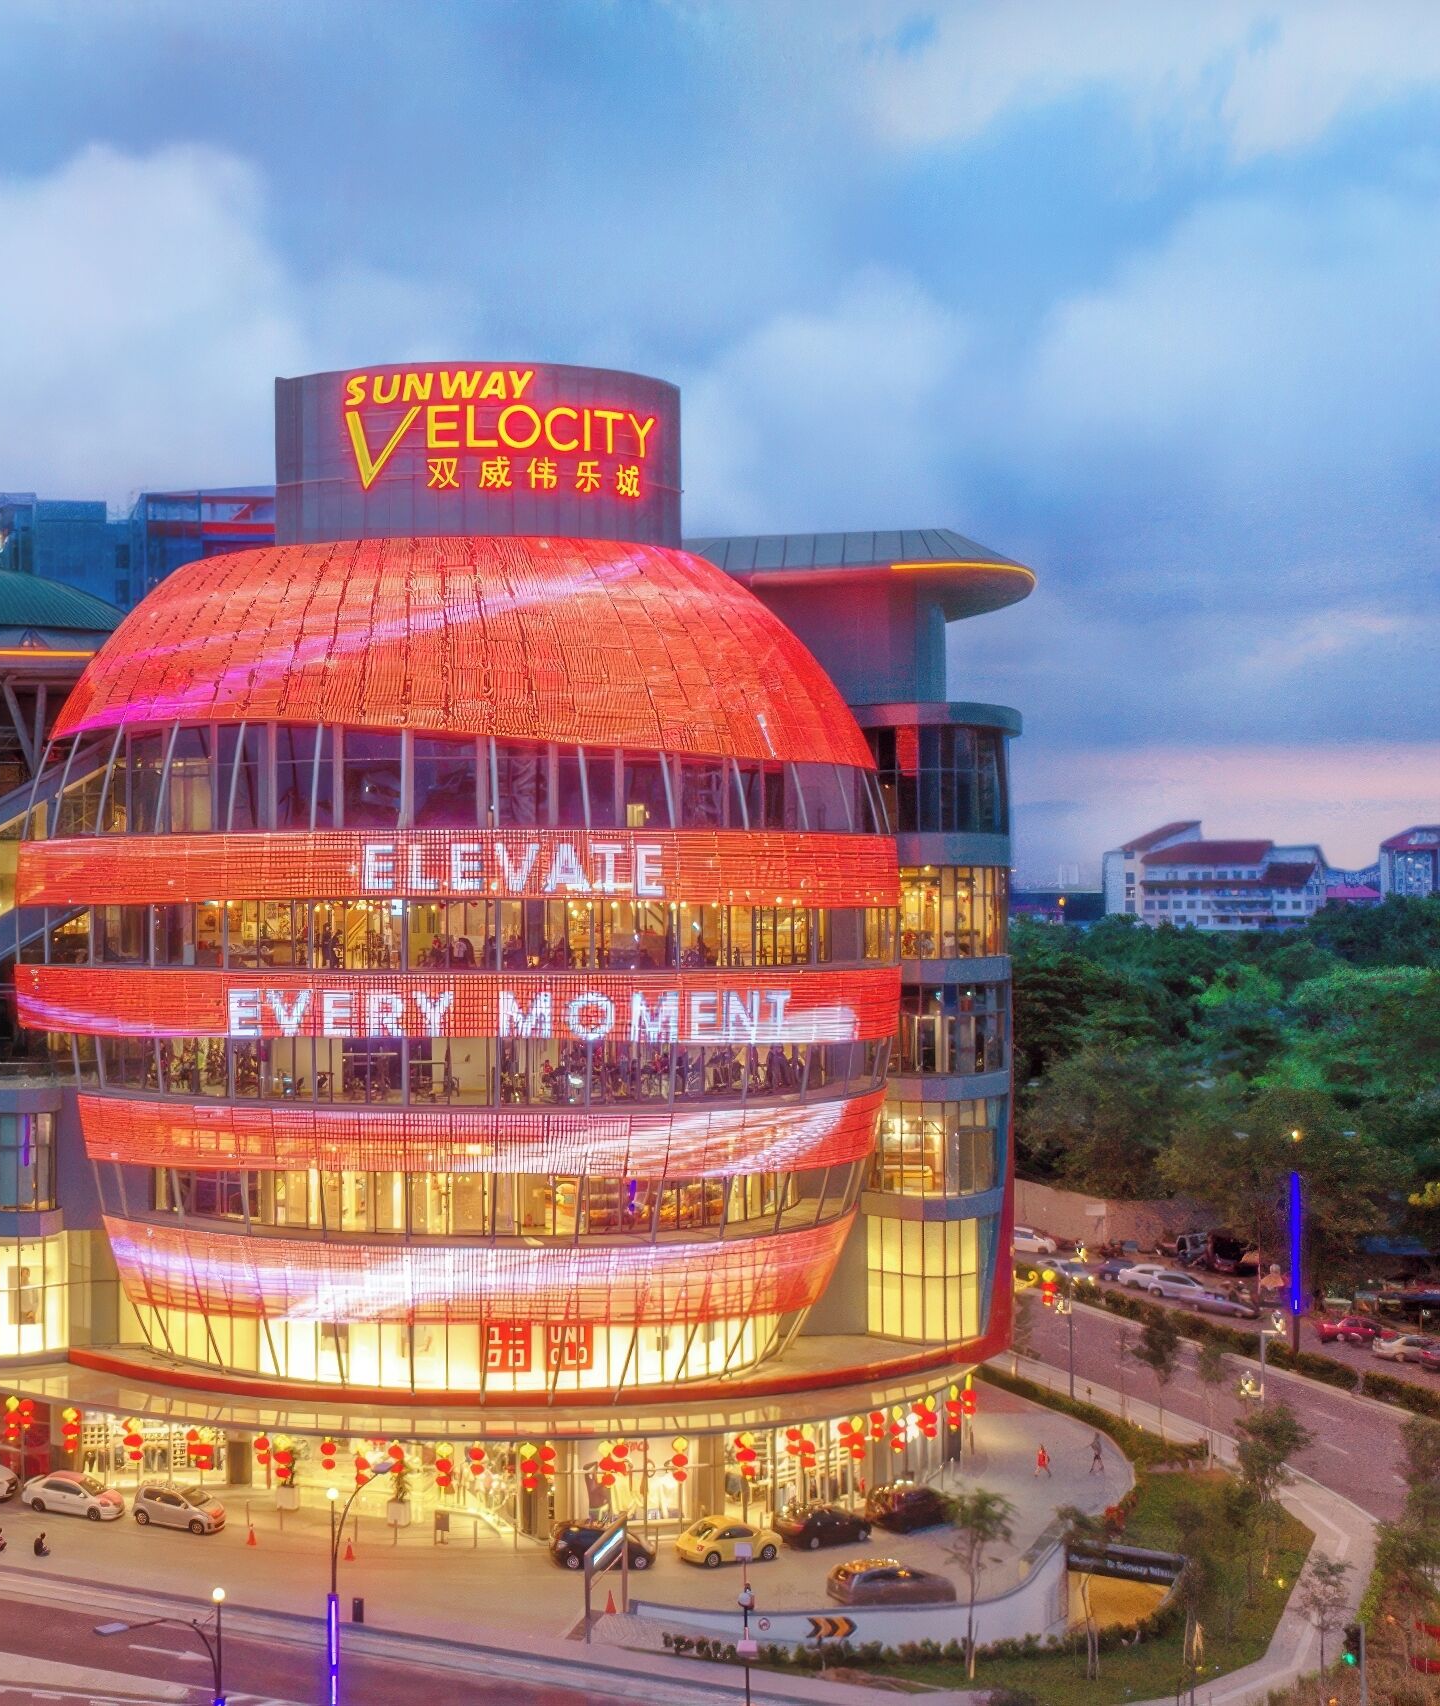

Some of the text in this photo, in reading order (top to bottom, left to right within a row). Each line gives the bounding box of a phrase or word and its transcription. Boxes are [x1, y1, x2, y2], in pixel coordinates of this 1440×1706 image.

[345, 370, 534, 405] SUNWAY
[346, 403, 655, 490] VELOCITY
[427, 456, 641, 498] 双威伟乐城
[363, 843, 665, 896] ELEVATE
[227, 987, 792, 1042] EVERY MOMENT
